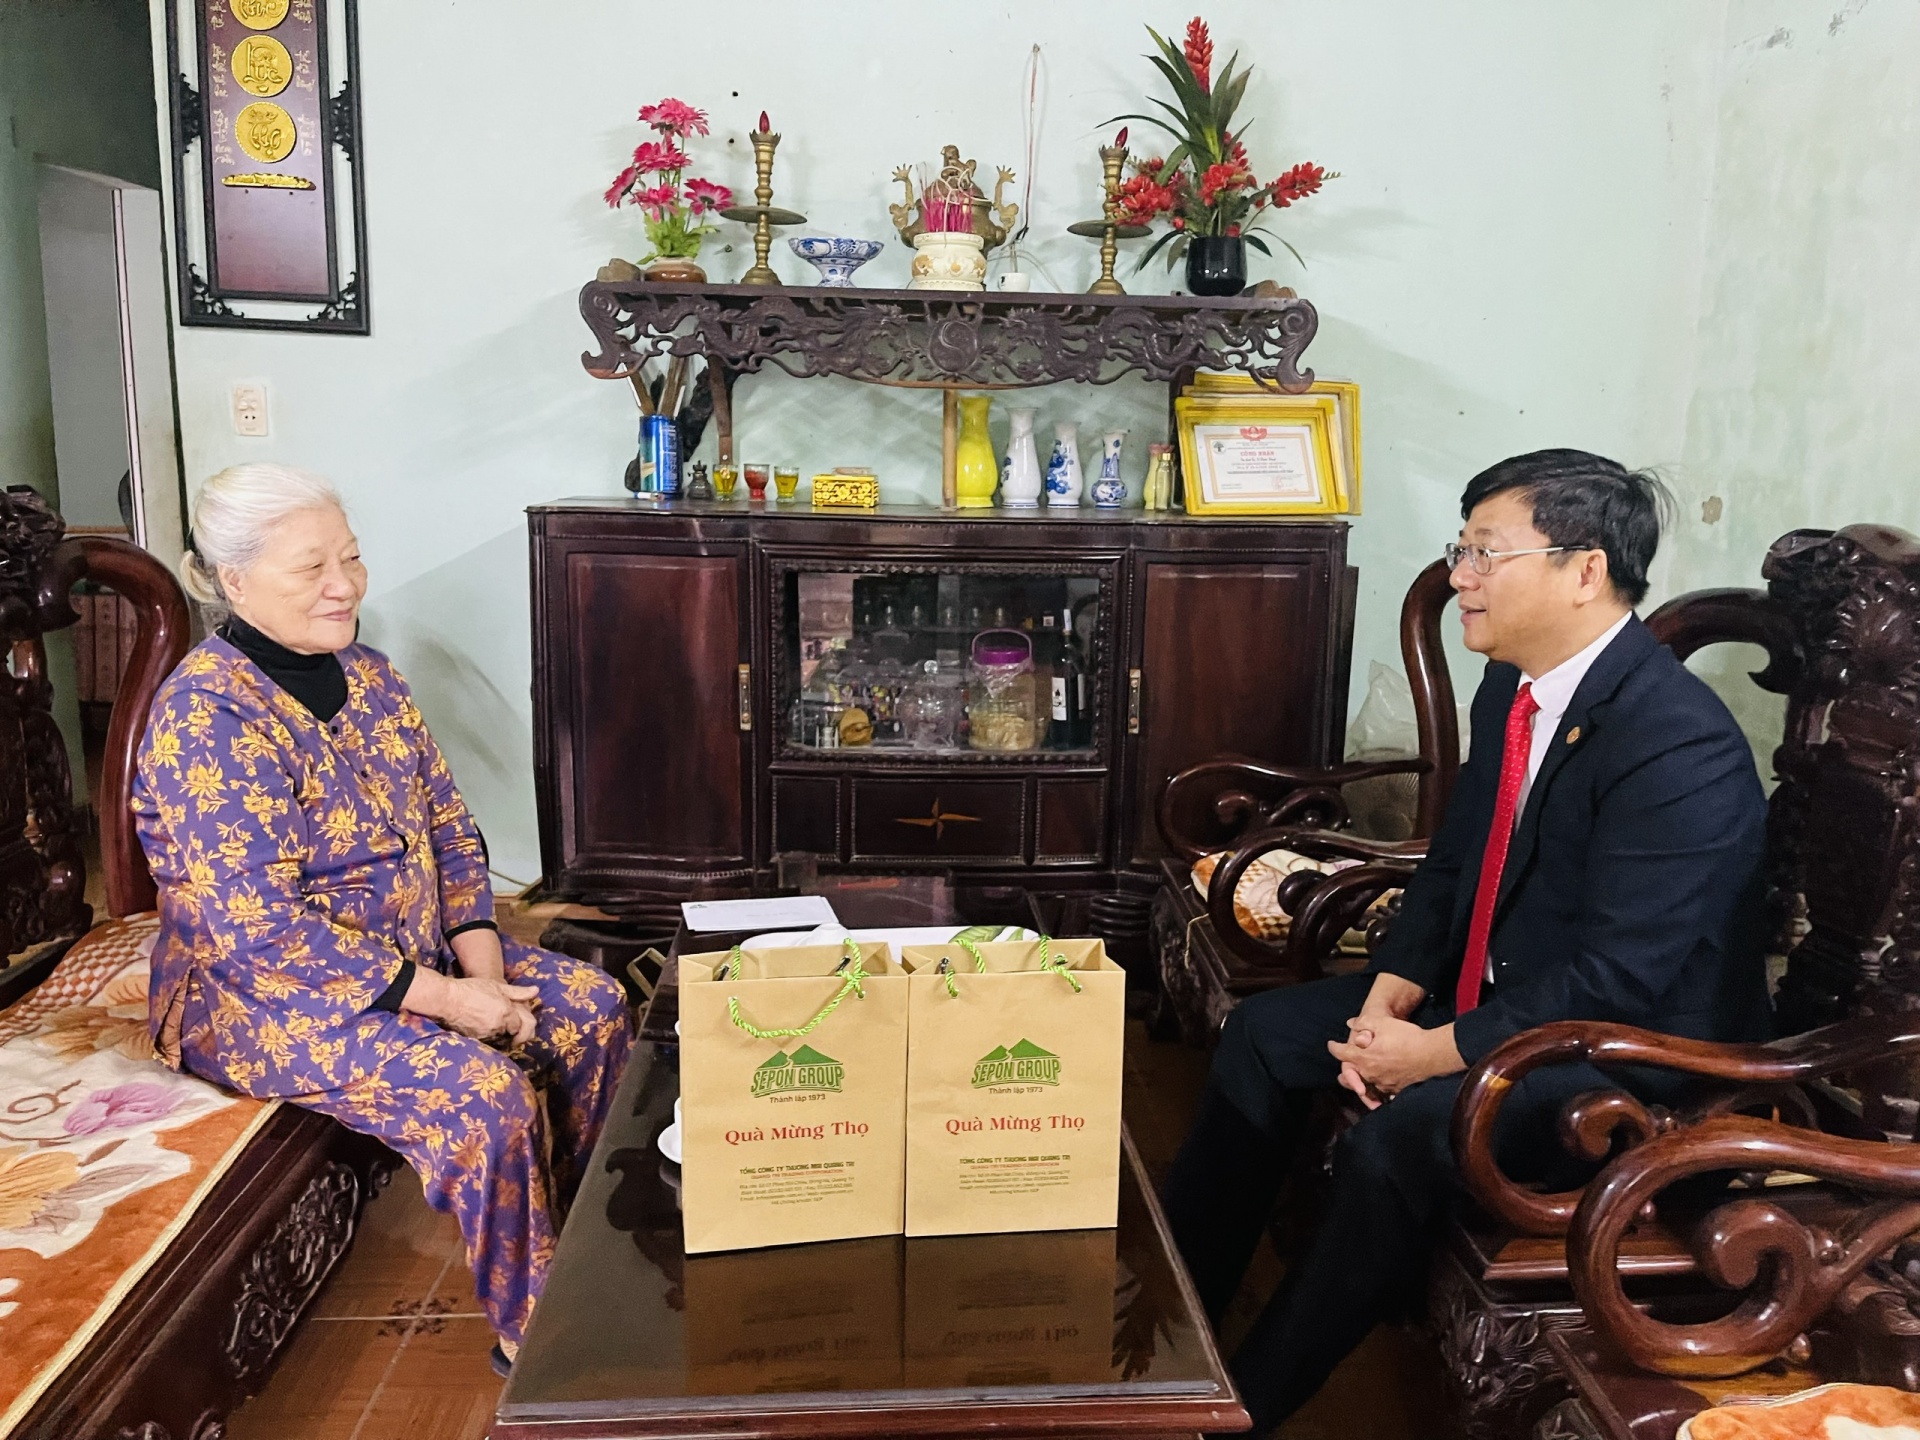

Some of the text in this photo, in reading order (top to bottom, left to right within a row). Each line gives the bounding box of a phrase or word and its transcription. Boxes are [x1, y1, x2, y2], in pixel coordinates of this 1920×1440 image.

[750, 1066, 844, 1092] SEPON GROUP
[971, 1058, 1061, 1084] SEPON GROUP
[725, 1120, 869, 1146] Quà Mừng Thọ
[945, 1115, 1085, 1135] Quà Mừng Thọ
